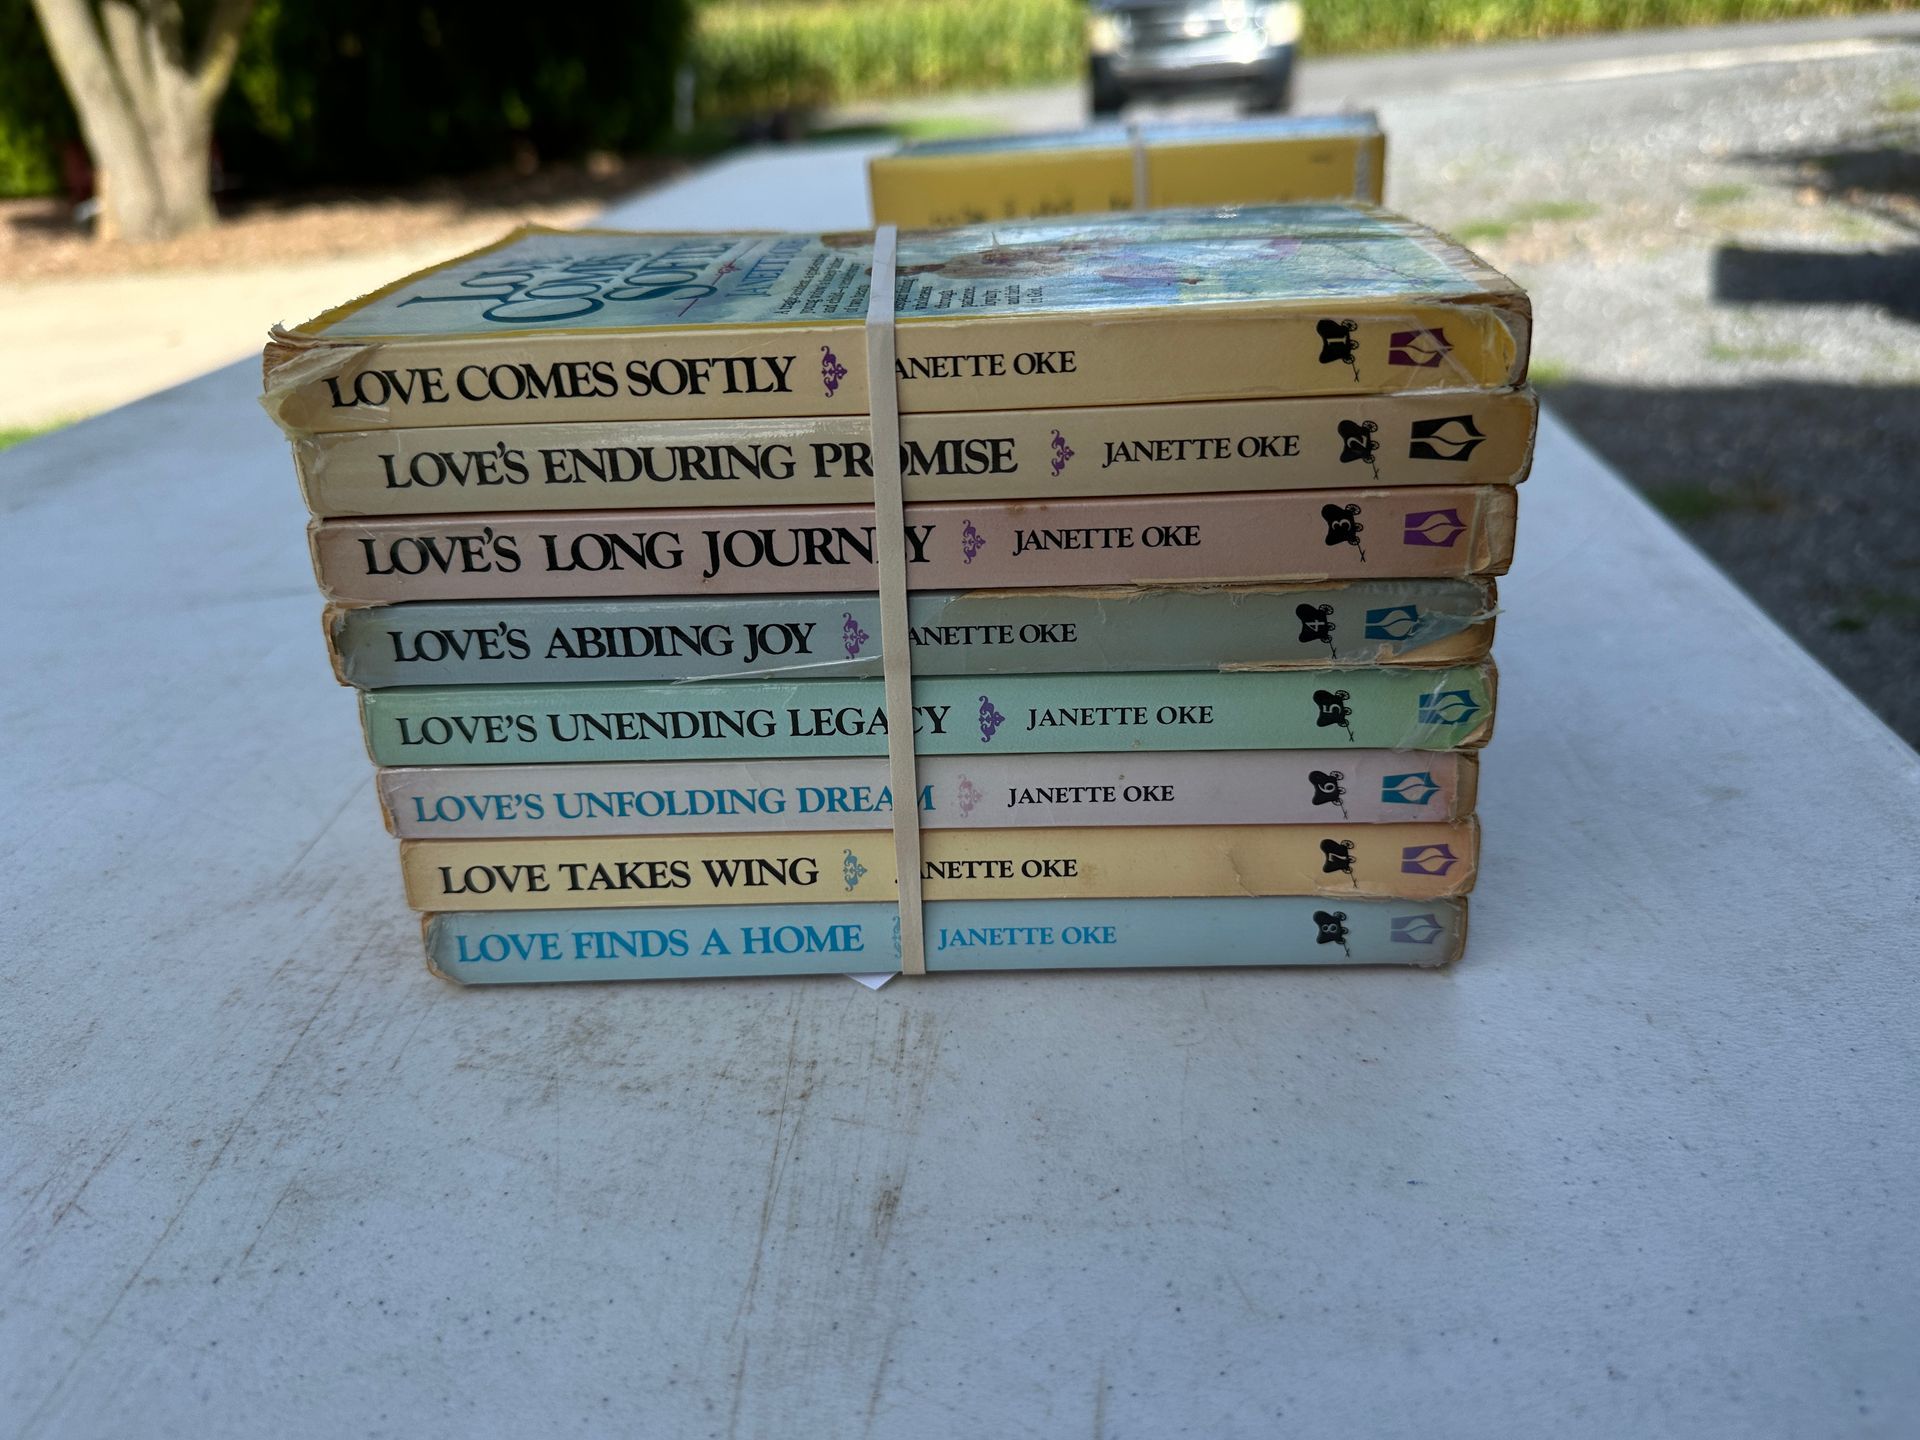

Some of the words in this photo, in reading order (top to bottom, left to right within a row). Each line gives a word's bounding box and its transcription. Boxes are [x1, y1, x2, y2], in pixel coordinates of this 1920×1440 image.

[321, 368, 449, 408] LOVE
[457, 361, 618, 401] COMES
[626, 356, 796, 396] SOFTLY
[897, 354, 1006, 379] ANETTE
[1014, 351, 1076, 375] OKE
[378, 441, 529, 488] LOVE'S
[538, 445, 796, 484] ENDURING
[1102, 438, 1231, 468] JANETTE
[1238, 435, 1300, 457] OKE
[358, 527, 521, 575] LOVE'S
[539, 532, 683, 571] LONG
[702, 525, 936, 578] JOURNY
[1013, 528, 1134, 556] JANETTE
[1142, 526, 1201, 547] OKE
[387, 622, 530, 662] LOVE'S
[545, 625, 734, 658] ABIDING
[743, 623, 816, 663] JOY
[911, 625, 1014, 645] ANETTE
[1019, 624, 1077, 643] OKE
[396, 715, 537, 745] LOVE'S
[546, 710, 776, 741] UNENDING
[1027, 707, 1148, 730] JANETTE
[1157, 706, 1213, 724] OKE
[412, 794, 544, 822] LOVE'S
[553, 788, 786, 819] UNFOLDING
[1008, 787, 1116, 807] JANETTE
[1123, 786, 1174, 802] OKE
[438, 865, 549, 894] LOVE
[559, 861, 691, 890] TAKES
[702, 858, 819, 887] WING
[895, 860, 1014, 884] NETTE
[1022, 860, 1077, 878] OKE
[457, 933, 562, 962] LOVE
[572, 929, 689, 959] FINDS
[702, 928, 731, 955] A
[741, 925, 864, 954] HOME
[938, 928, 1054, 950] JANETTE
[1062, 927, 1116, 944] OKE
